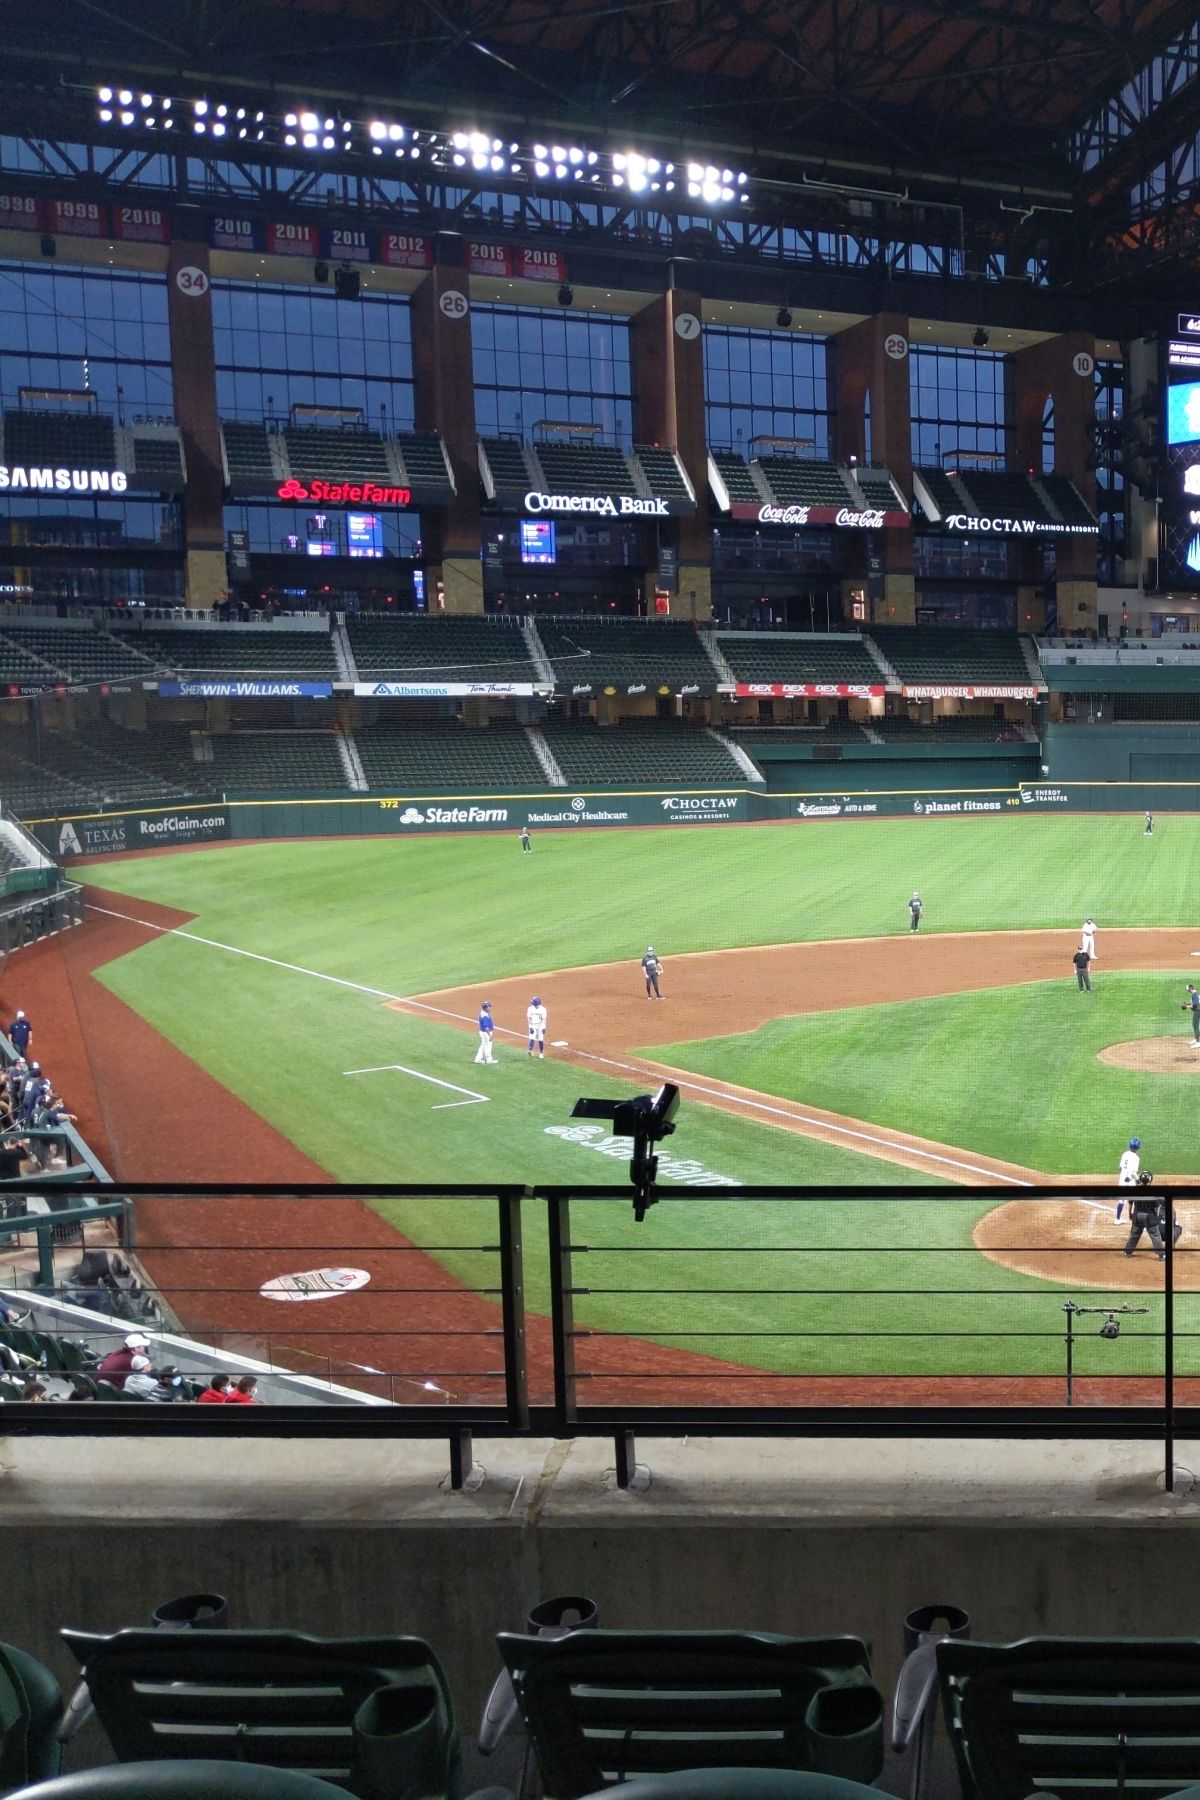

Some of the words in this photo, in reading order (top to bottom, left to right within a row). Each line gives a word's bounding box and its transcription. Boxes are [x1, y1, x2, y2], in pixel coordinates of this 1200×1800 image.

[55, 201, 99, 219] 1999
[121, 208, 161, 225] 2010
[214, 218, 251, 234] 2010
[276, 224, 310, 241] 2011
[333, 230, 366, 247] 2011
[388, 234, 424, 251] 2012
[470, 244, 504, 260] 2015
[524, 249, 558, 266] 2016
[180, 272, 205, 290] 34
[443, 296, 464, 313] 26
[683, 319, 694, 334] 7
[887, 339, 905, 354] 29
[1076, 357, 1089, 371] 10
[0, 466, 127, 492] SAMSUNG
[310, 481, 410, 504] StateFarm
[620, 496, 669, 515] Bank
[758, 504, 810, 524] Coca-Cola
[836, 508, 886, 528] Coca-Cola
[955, 515, 1036, 533] CHOCTAW
[1036, 524, 1064, 532] CASINOS
[393, 686, 447, 695] Albertsons
[467, 684, 485, 692] Tom
[485, 684, 515, 692] Thumb
[906, 687, 968, 697] WHATABURGER
[973, 687, 1033, 697] WHATABURGER
[670, 798, 737, 809] CHOCTAW
[925, 801, 961, 814] planet
[964, 800, 1001, 811] fitness
[426, 808, 508, 823] StateFarm
[528, 812, 562, 822] Medical
[562, 812, 581, 823] City
[582, 810, 628, 820] Healthcare
[140, 816, 225, 834] RoofClaim.com
[84, 828, 126, 844] TEXAS
